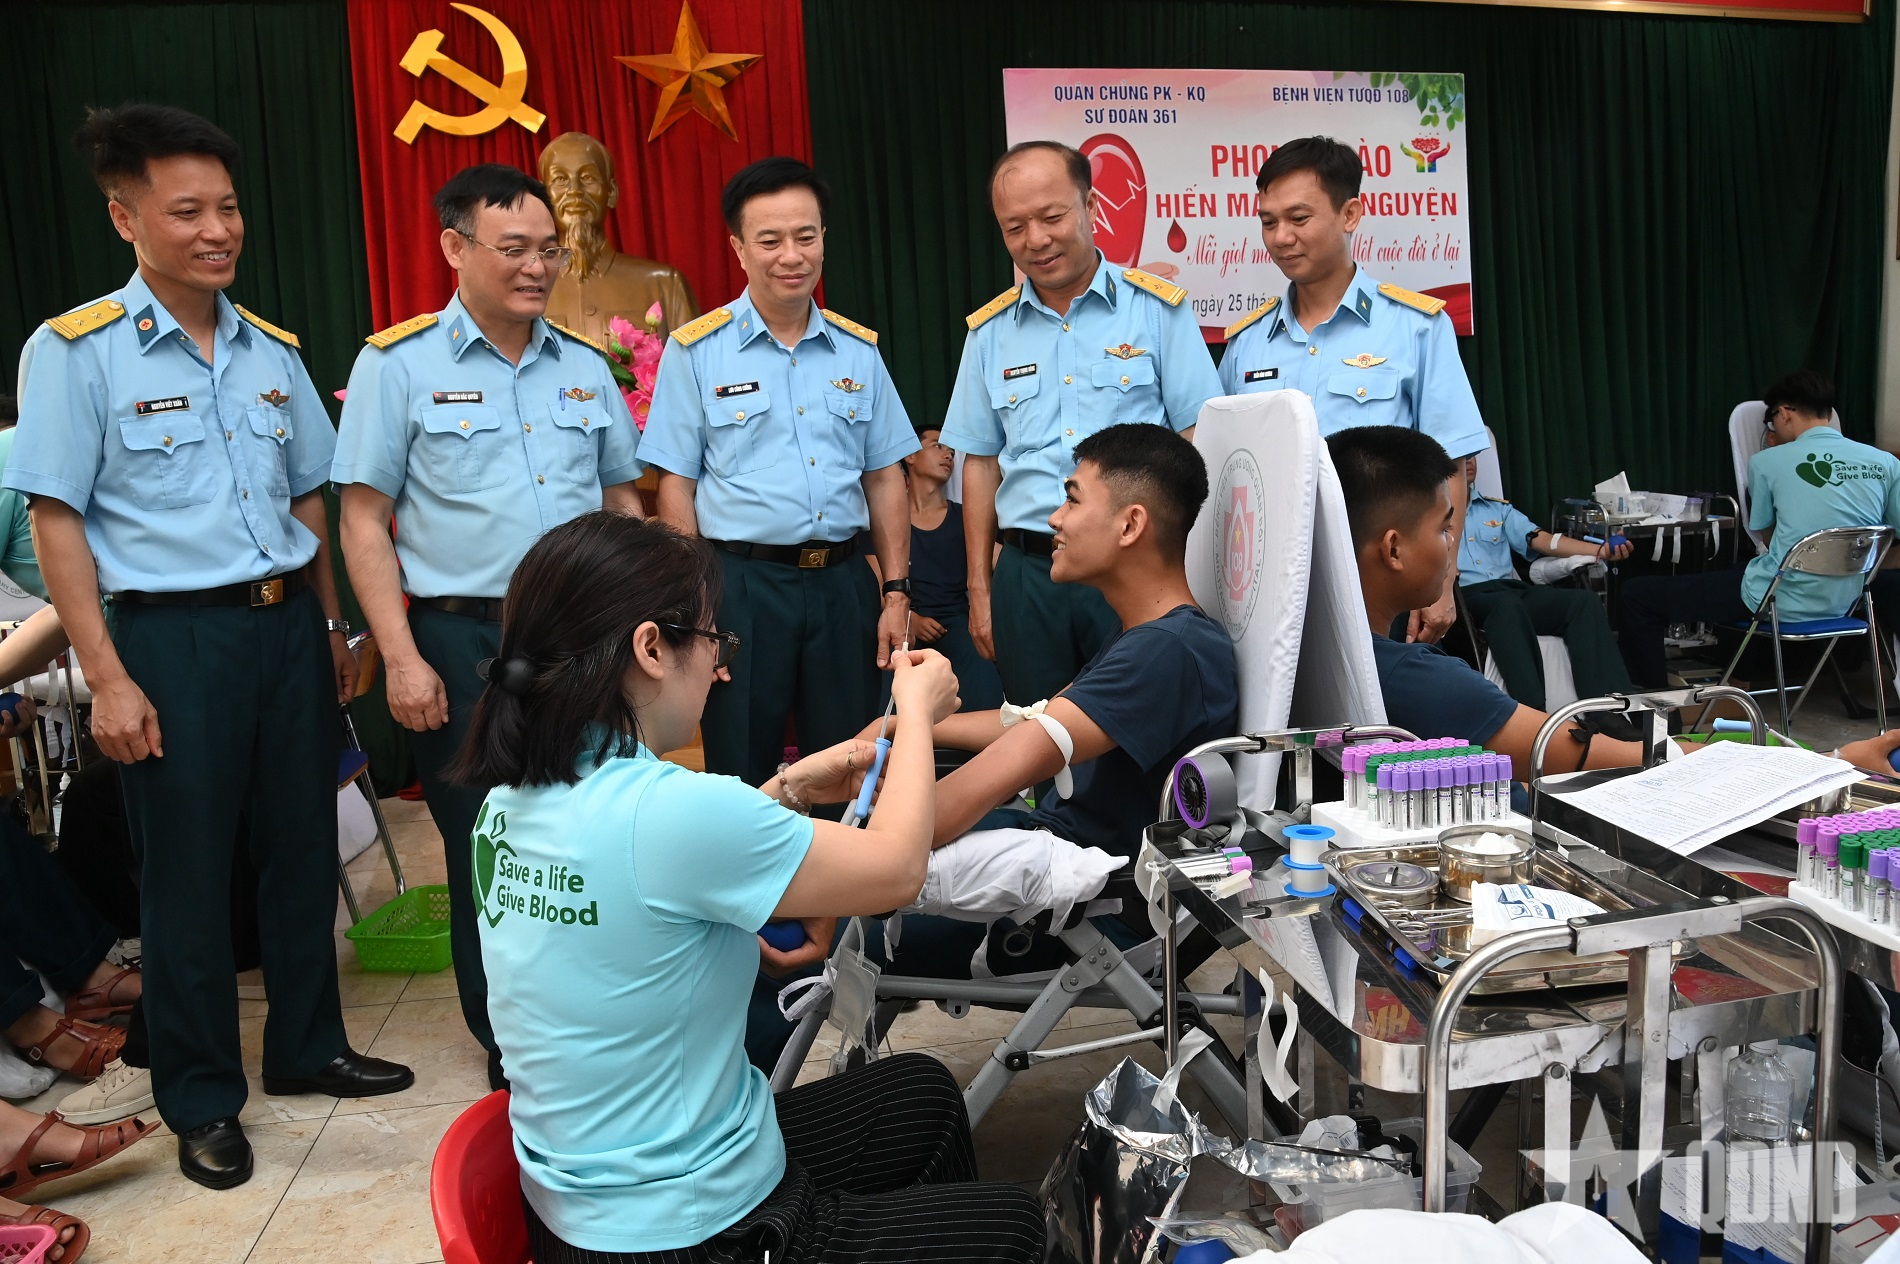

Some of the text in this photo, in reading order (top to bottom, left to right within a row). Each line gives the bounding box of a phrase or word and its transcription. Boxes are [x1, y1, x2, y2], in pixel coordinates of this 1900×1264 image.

[1054, 83, 1094, 102] QUÂN
[1099, 81, 1149, 101] CHỦNG
[1153, 86, 1172, 101] PK
[1187, 86, 1206, 102] KQ
[1272, 84, 1309, 105] BỆNH
[1313, 84, 1344, 105] VIỆN
[1387, 89, 1409, 103] 108
[1084, 105, 1177, 124] SƯ ĐOÀN 361
[1211, 138, 1392, 178] PHO ÀO
[1155, 183, 1217, 218] HIẾN
[1360, 187, 1457, 222] NGUYỆN
[1187, 234, 1217, 265] Mỗi
[1220, 237, 1248, 278] giọt
[1377, 240, 1403, 270] cuộc
[1408, 235, 1427, 261] đời
[1431, 233, 1440, 261] ở
[1444, 233, 1461, 270] lại
[1192, 294, 1224, 317] ngày
[1228, 294, 1243, 311] 25
[1834, 464, 1859, 472] Save
[1836, 472, 1859, 480] Give
[1231, 551, 1243, 572] 108
[498, 854, 585, 893] Save a life
[497, 884, 599, 926] Give Blood
